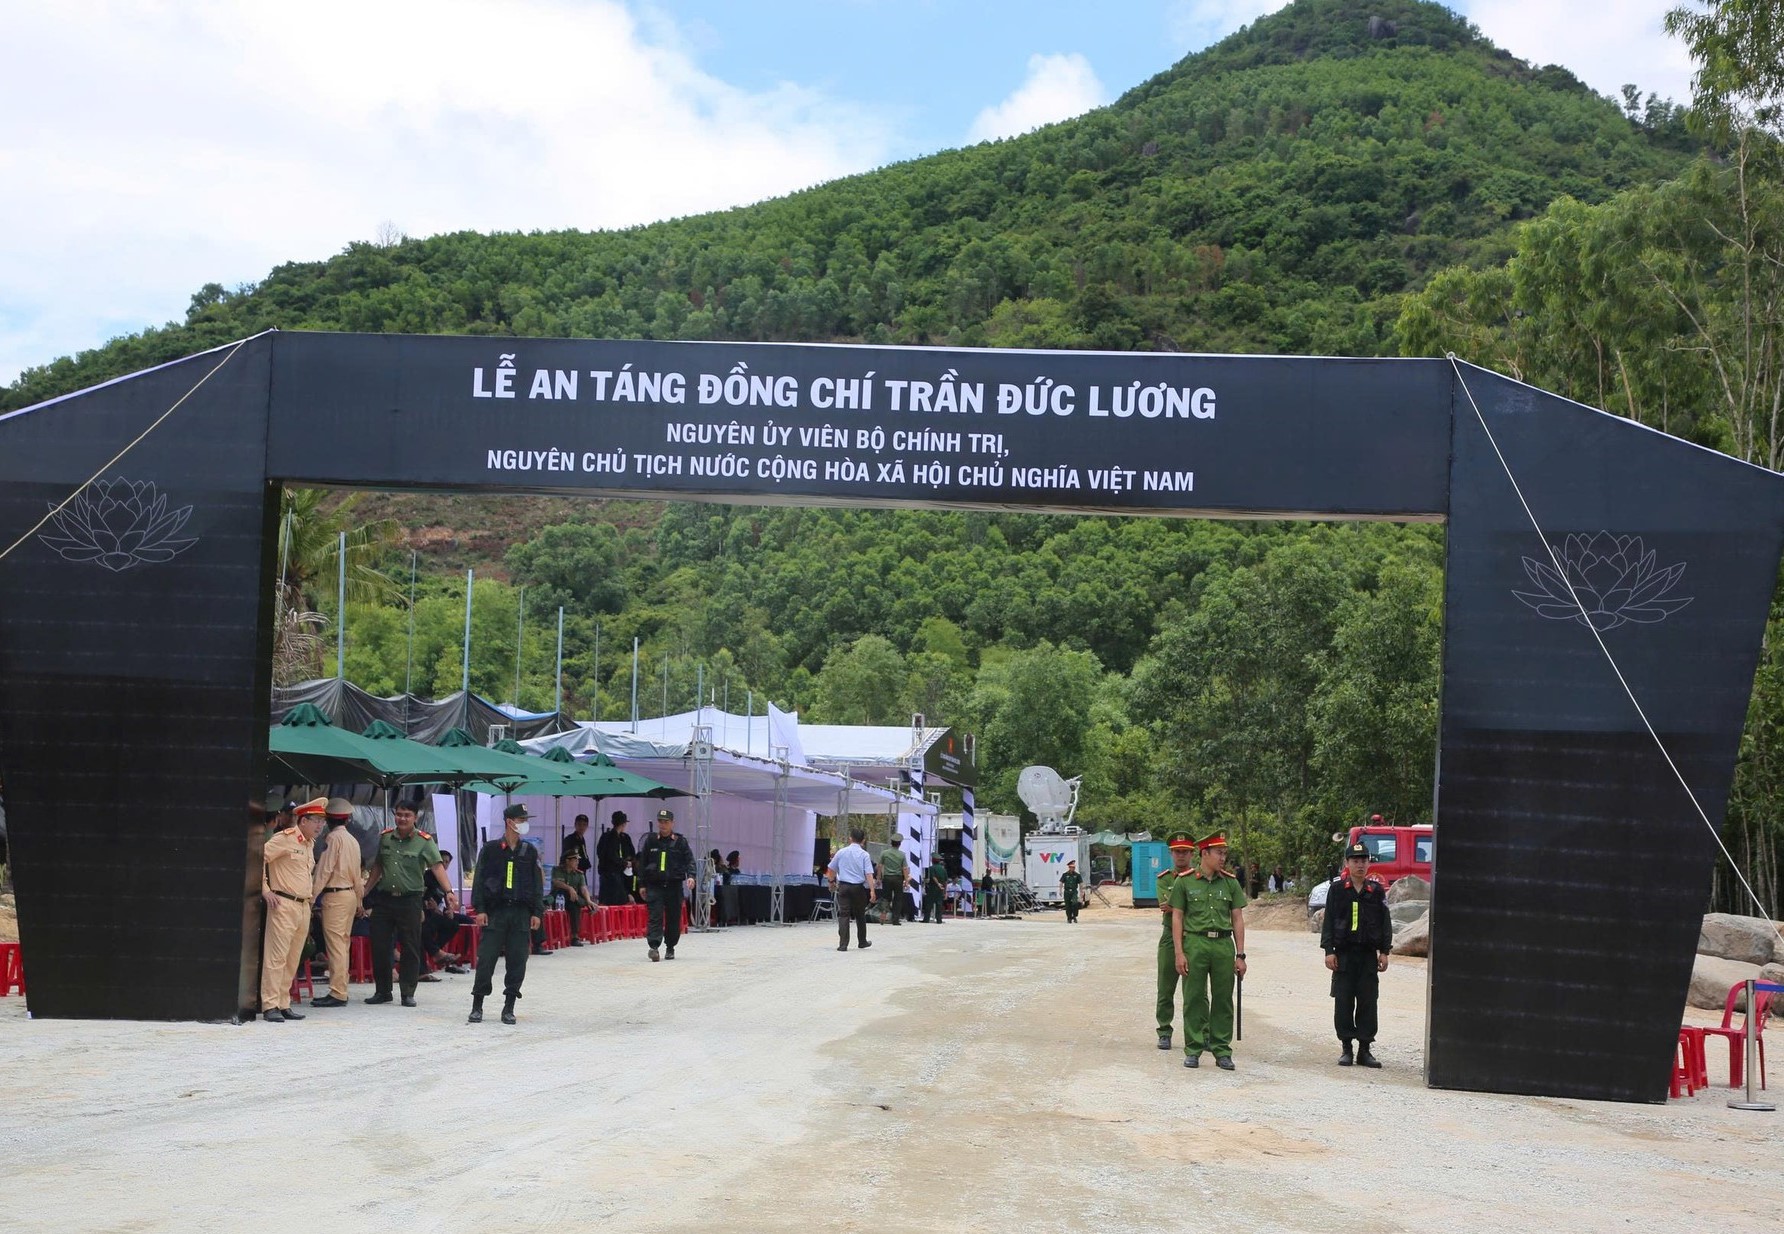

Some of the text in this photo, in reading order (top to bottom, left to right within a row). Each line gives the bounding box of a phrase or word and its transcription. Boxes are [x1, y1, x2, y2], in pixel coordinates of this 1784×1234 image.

[473, 353, 1216, 419] LỄ AN TÁNG ĐỒNG CHÍ TRẦN ĐỨC LƯƠNG
[667, 420, 1009, 458] NGUYÊN ỦY VIÊN BỘ CHÍNH TRỊ,
[487, 447, 1194, 495] NGUYÊN CHỦ TỊCH NƯỚC CỘNG HÒA XÃ HỘI CHỦ NGHĨA VIỆT NAM
[1039, 853, 1065, 863] VTV
